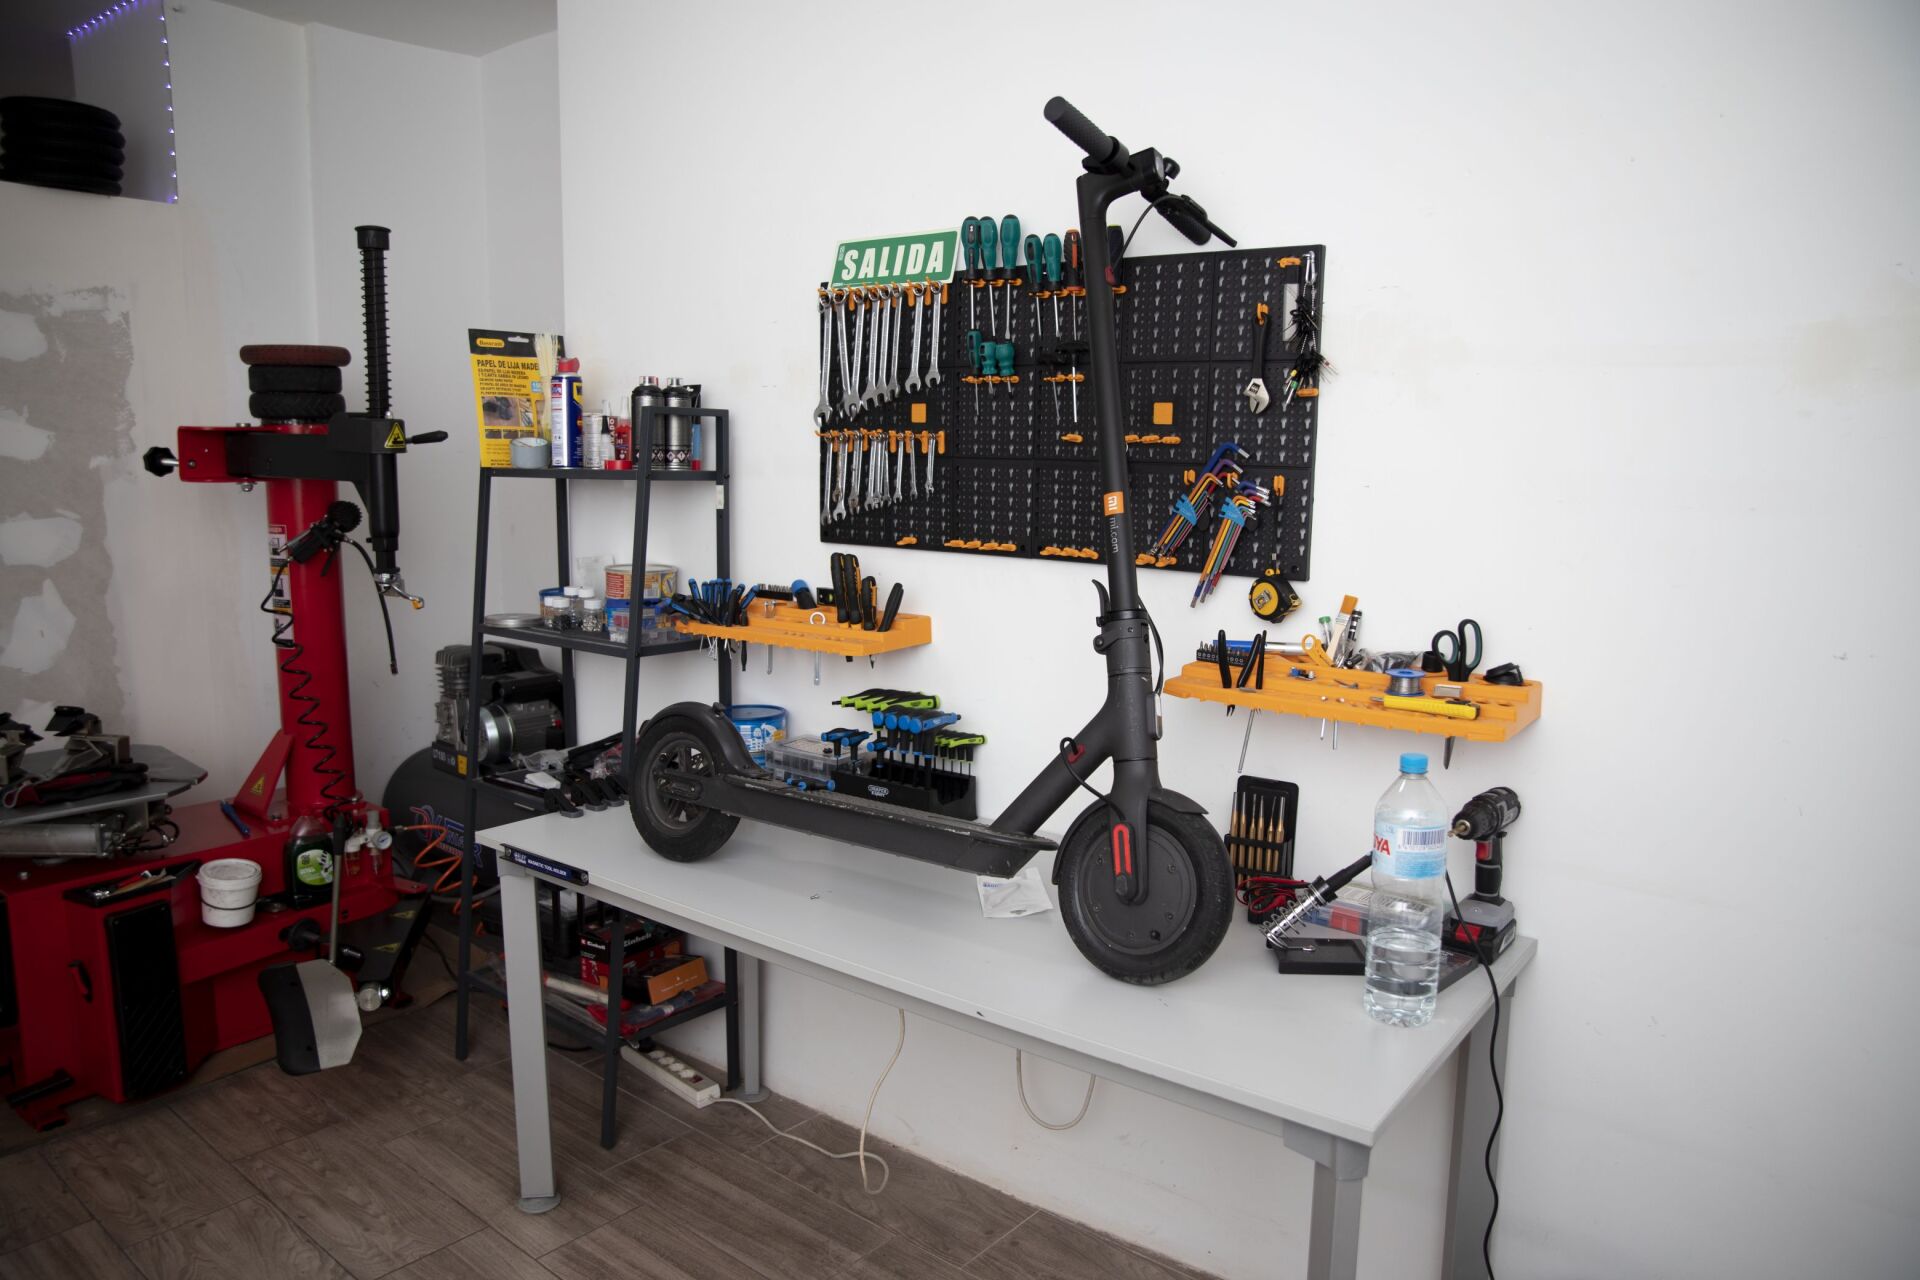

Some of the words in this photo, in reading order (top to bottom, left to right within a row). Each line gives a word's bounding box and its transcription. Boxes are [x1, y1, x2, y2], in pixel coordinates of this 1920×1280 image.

[841, 241, 944, 280] SALIDA
[477, 360, 497, 368] PAPEL
[499, 361, 506, 369] DE
[507, 361, 520, 370] LIJA
[521, 363, 540, 371] MADE
[1109, 517, 1119, 553] mi.com
[1374, 833, 1391, 856] YA
